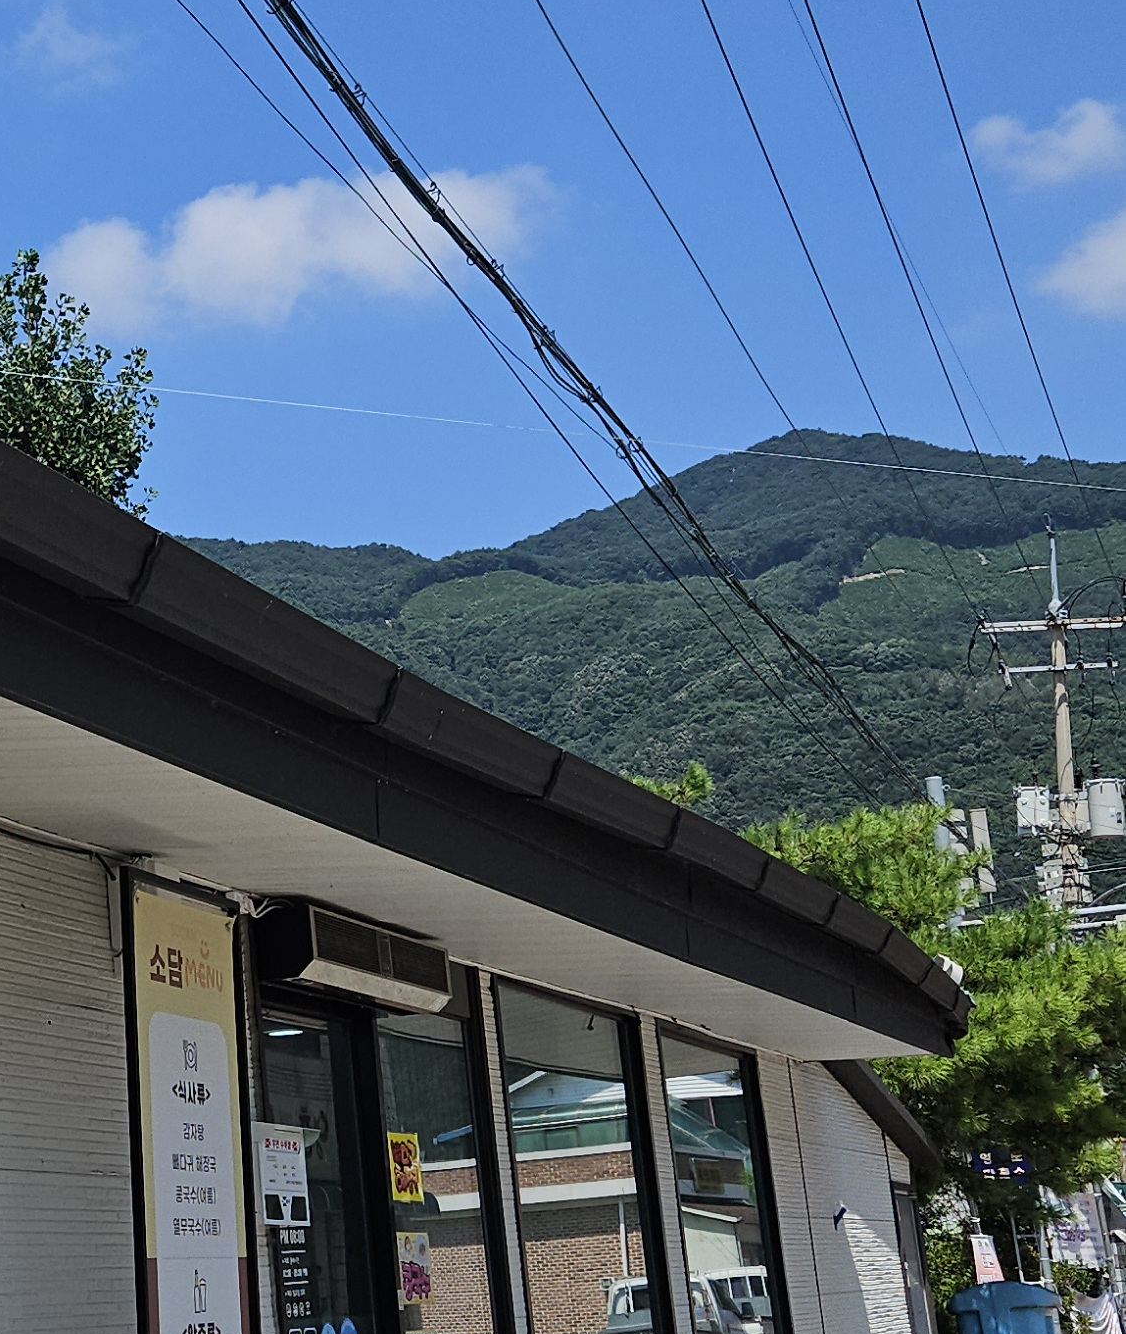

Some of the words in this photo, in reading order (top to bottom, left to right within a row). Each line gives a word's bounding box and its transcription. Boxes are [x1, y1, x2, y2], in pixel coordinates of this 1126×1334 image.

[149, 944, 183, 989] 소담
[182, 1122, 205, 1141] 감자탕
[196, 1155, 217, 1173] 해장국
[175, 1185, 217, 1205] 콩국수(여름)
